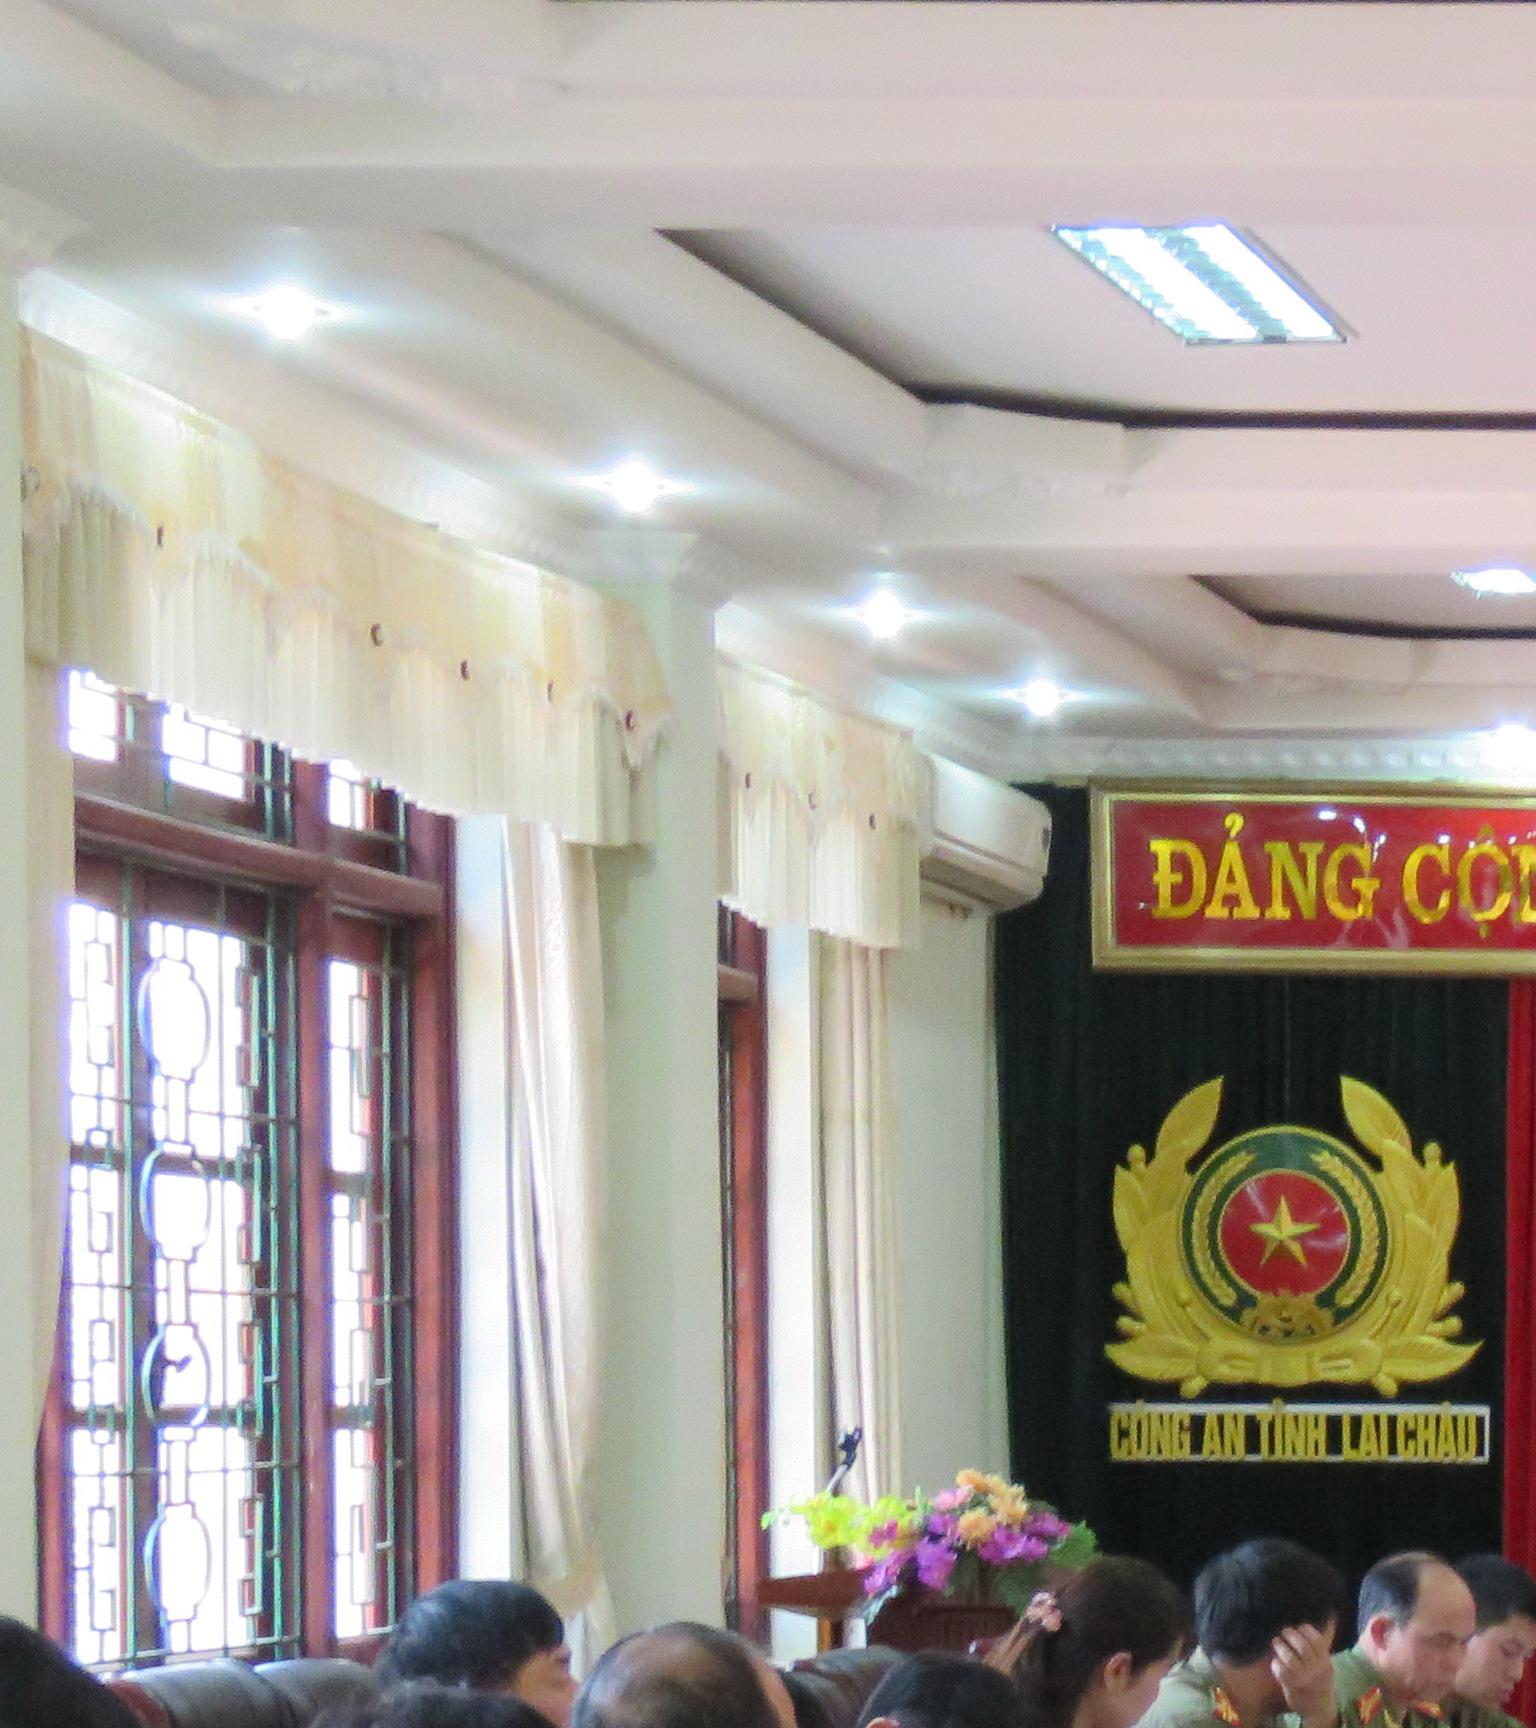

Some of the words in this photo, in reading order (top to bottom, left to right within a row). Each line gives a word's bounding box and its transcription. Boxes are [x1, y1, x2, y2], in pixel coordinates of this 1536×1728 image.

[1149, 812, 1377, 922] ĐẢNG
[1201, 1408, 1247, 1460] AN
[1339, 1408, 1391, 1462] LAI
